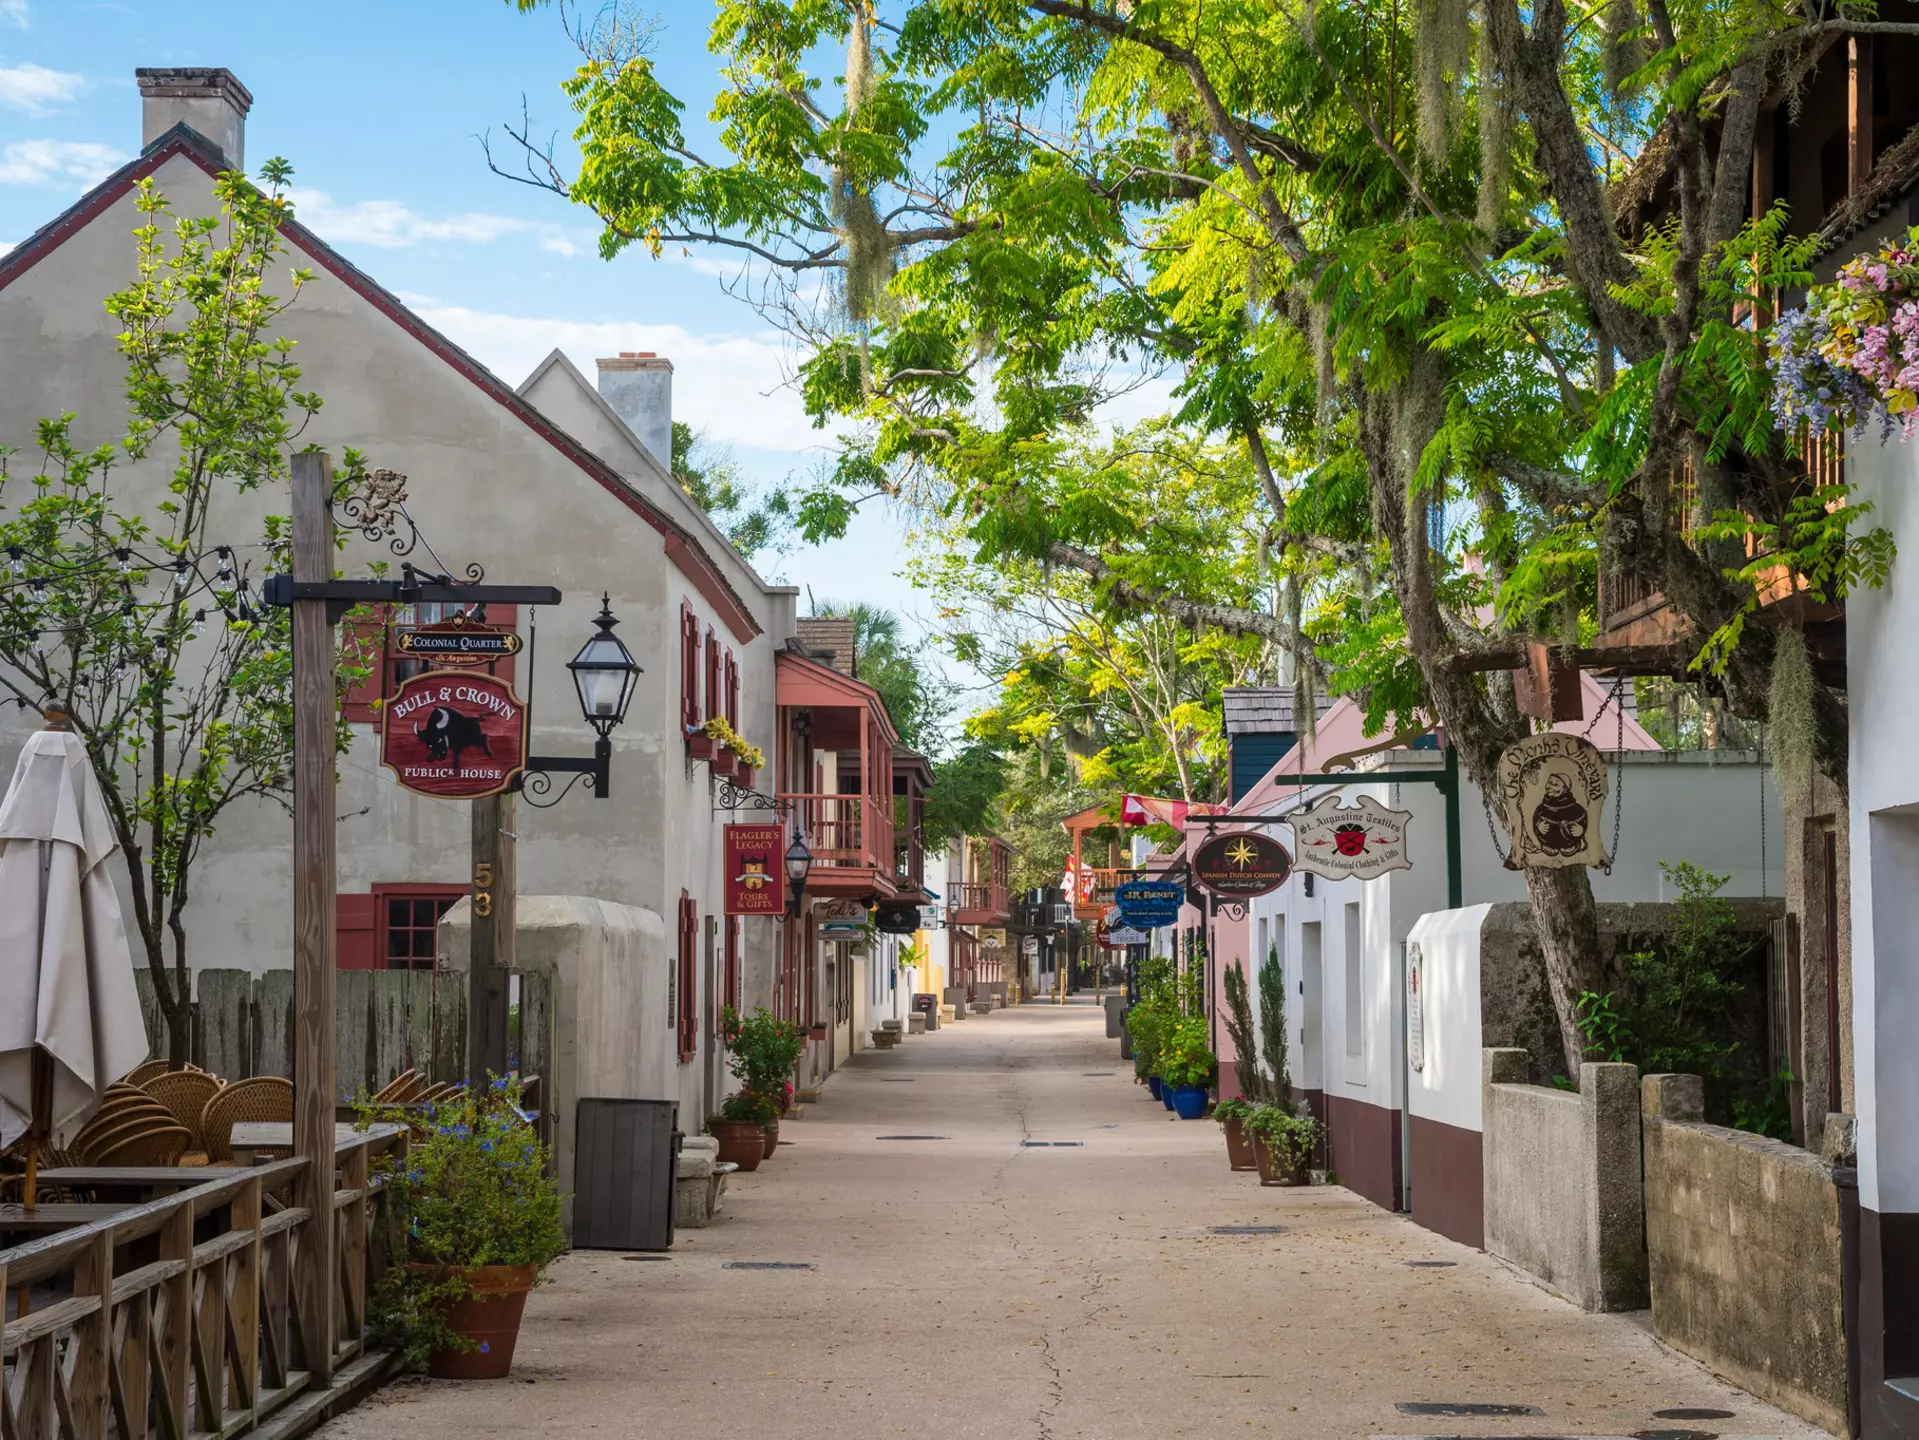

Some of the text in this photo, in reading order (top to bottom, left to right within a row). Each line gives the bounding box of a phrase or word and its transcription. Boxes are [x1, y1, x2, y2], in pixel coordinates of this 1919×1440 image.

[413, 636, 503, 650] COLONIAL QUARTER
[393, 686, 516, 721] BULL & CROWN
[460, 768, 502, 779] HOUSE
[1503, 771, 1520, 800] The
[1299, 811, 1401, 836] St. Augustine Textiles
[730, 830, 779, 840] FLAGLER'S
[735, 840, 774, 850] LEGACY
[1304, 850, 1331, 868] Authentic
[1330, 859, 1355, 870] Colonial
[1355, 857, 1380, 869] Clothing
[1385, 849, 1400, 860] Gifts
[1253, 871, 1281, 879] CONVOY
[738, 892, 769, 900] TOURS
[736, 900, 773, 908] & GIFTS
